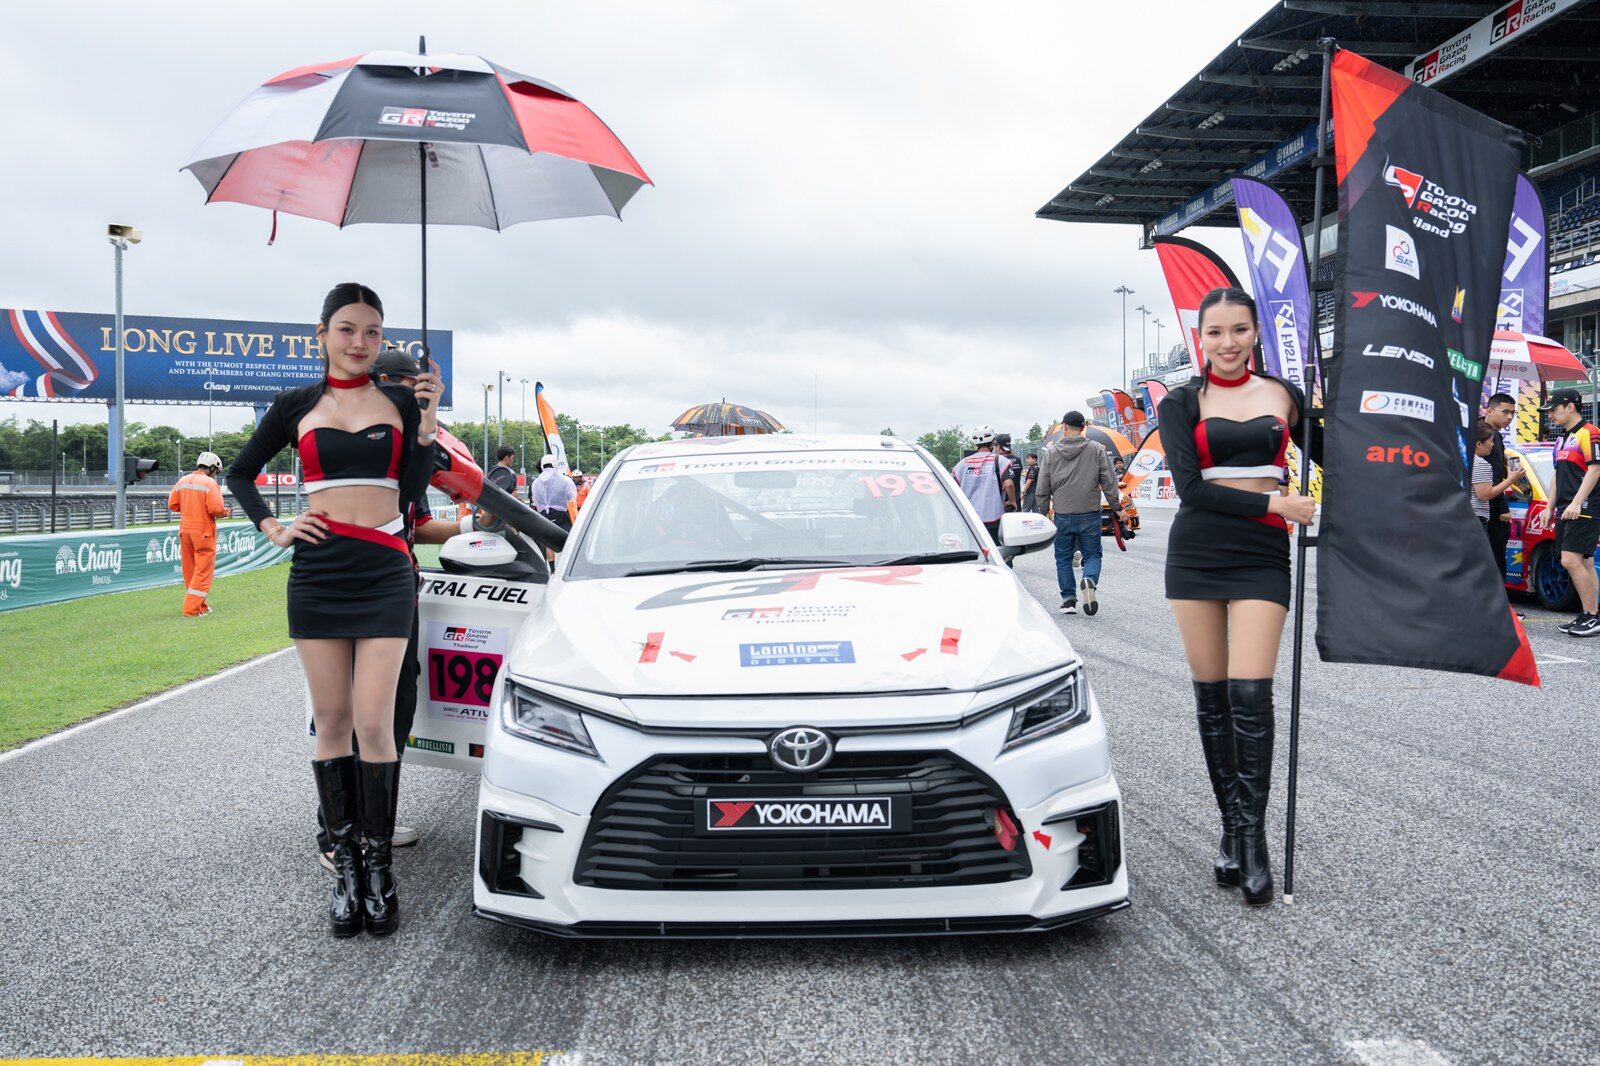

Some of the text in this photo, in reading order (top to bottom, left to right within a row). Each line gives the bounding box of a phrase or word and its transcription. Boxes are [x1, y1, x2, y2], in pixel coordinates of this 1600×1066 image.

[1522, 4, 1556, 26] Racing
[1493, 13, 1522, 42] GR
[1439, 44, 1468, 65] GAZOO
[1441, 33, 1472, 55] TOYOTA
[1413, 61, 1437, 84] GR
[1438, 54, 1467, 74] Racing
[381, 112, 420, 125] GR
[426, 116, 470, 124] GAZOO
[429, 110, 476, 119] TOYOTA
[426, 120, 466, 131] Racing
[1281, 136, 1305, 159] YAMAHA
[1420, 191, 1470, 222] GAOO
[1425, 180, 1477, 215] TOOTA
[1379, 294, 1438, 328] YOKOHAMA
[100, 326, 197, 355] LONG
[205, 331, 276, 358] LIVE
[175, 360, 195, 368] WITH
[198, 361, 213, 369] THE
[214, 361, 245, 370] UTMOST
[1362, 343, 1435, 370] LENSO
[256, 371, 282, 379] CHANG
[204, 381, 231, 393] Chang
[1394, 397, 1433, 412] COMPACT
[682, 461, 758, 469] TOYOTA
[765, 458, 836, 467] GAZOO
[841, 457, 906, 466] Racing
[1366, 444, 1431, 468] arto
[858, 471, 941, 498] 198
[229, 531, 255, 555] Chang
[78, 542, 122, 574] Chang
[473, 584, 529, 604] FUEL
[444, 632, 465, 641] GR
[750, 643, 818, 656] Lamina
[750, 657, 842, 665] DIGITAL
[431, 653, 499, 704] 198
[417, 739, 453, 753] MODELLISTA
[754, 803, 886, 825] YOKOHAMA
